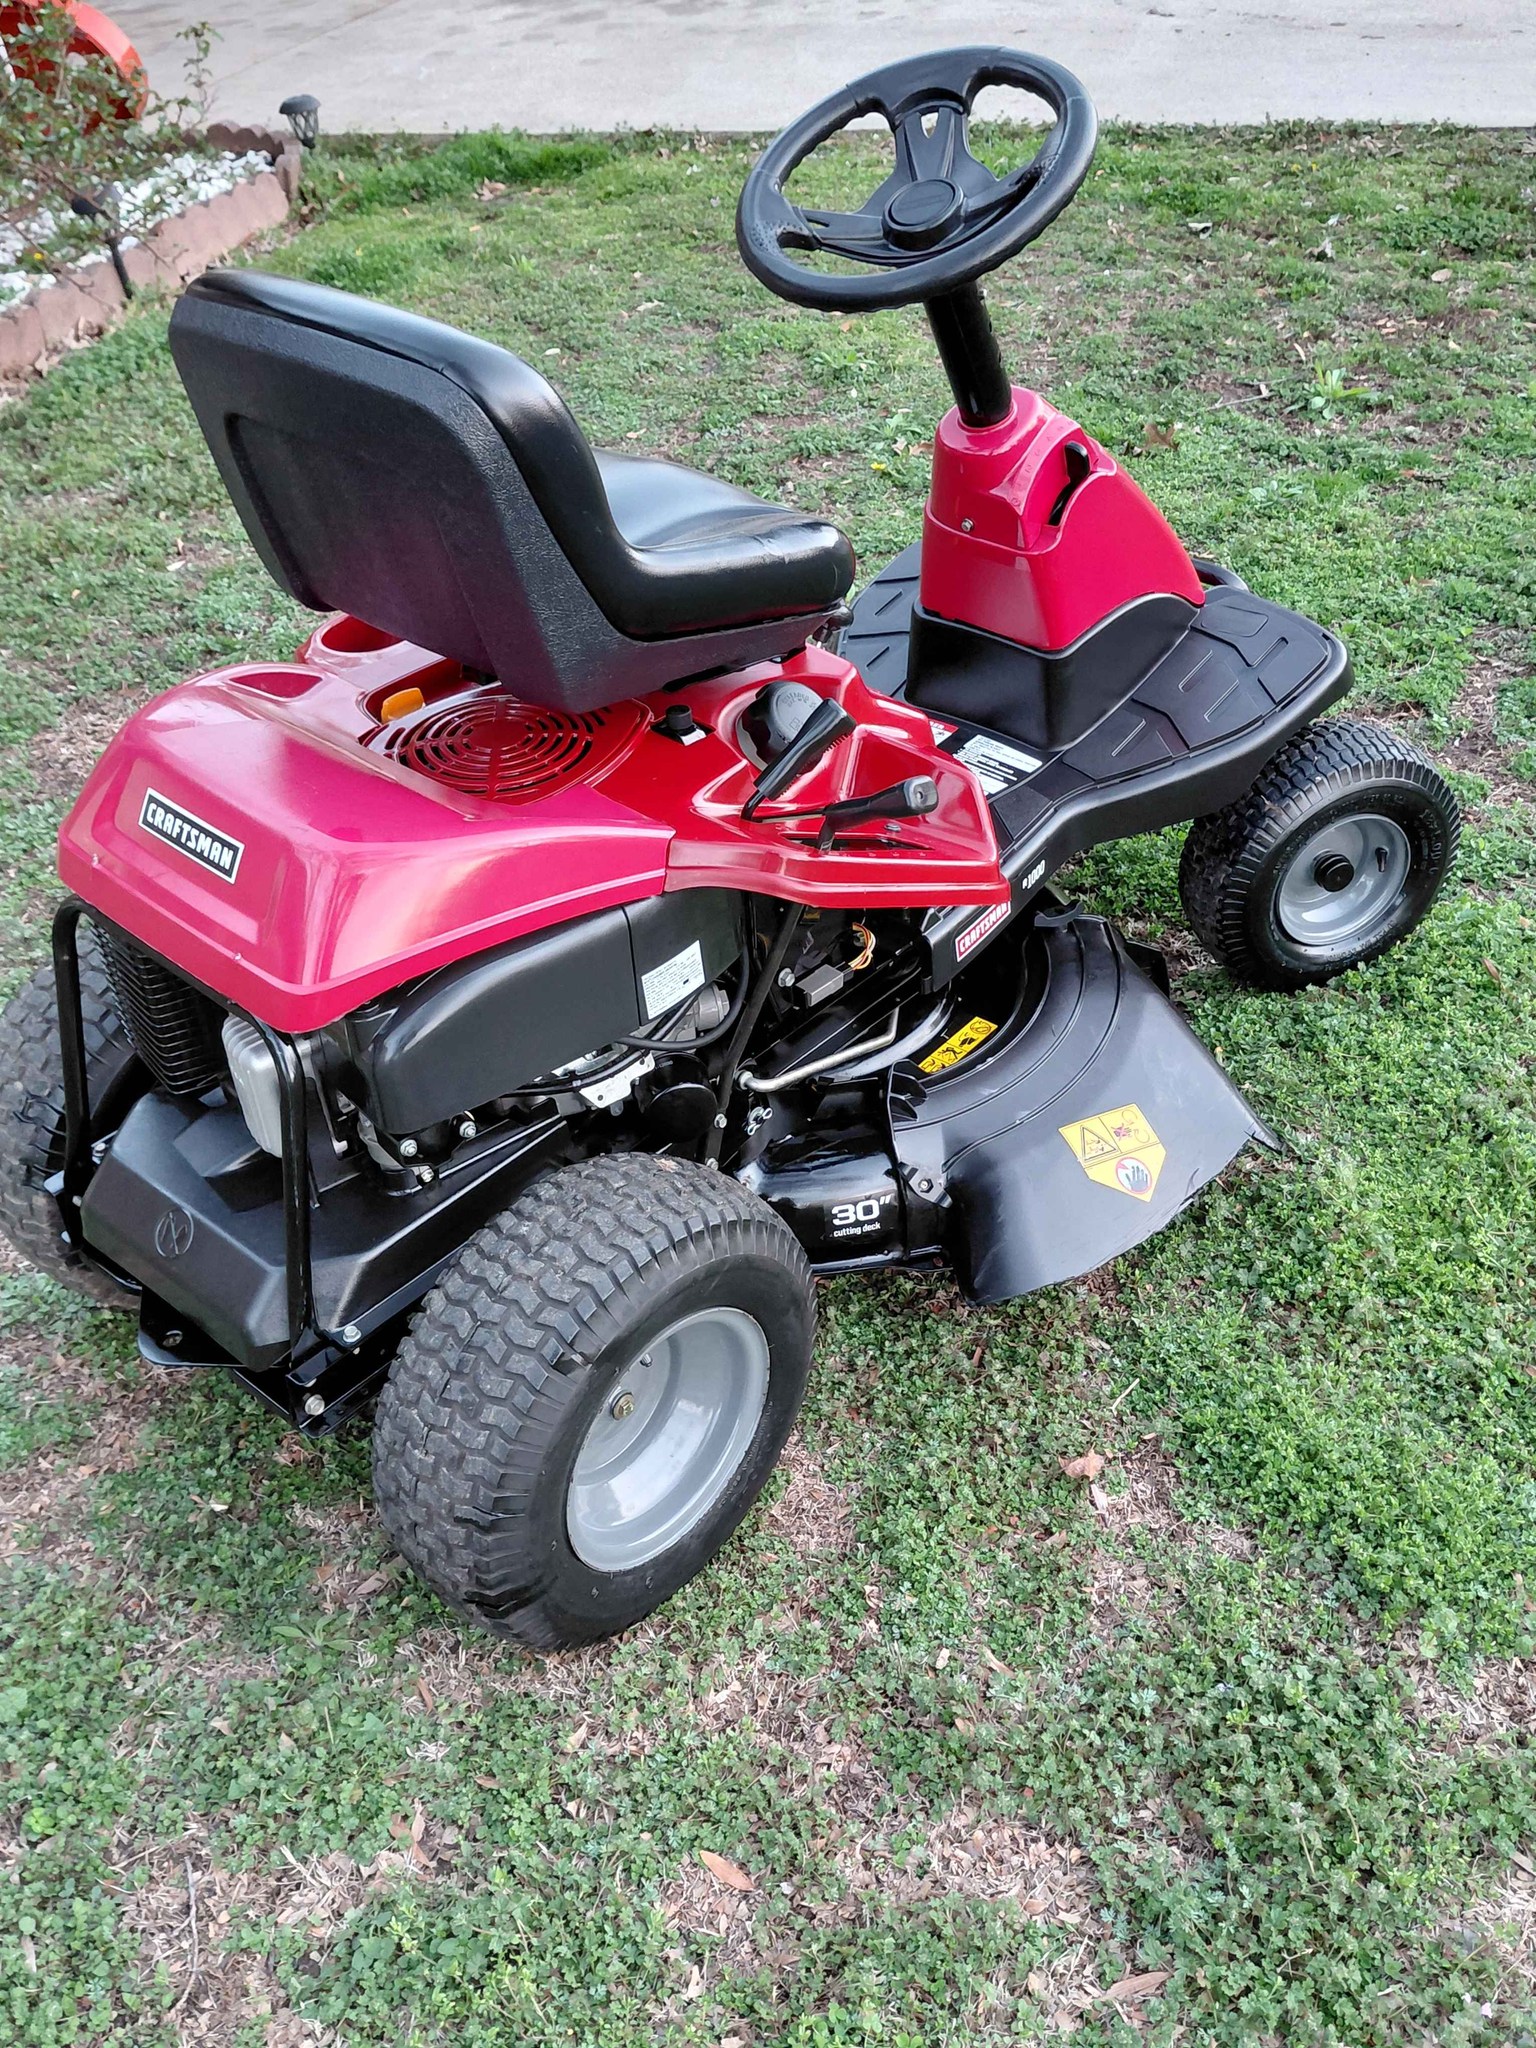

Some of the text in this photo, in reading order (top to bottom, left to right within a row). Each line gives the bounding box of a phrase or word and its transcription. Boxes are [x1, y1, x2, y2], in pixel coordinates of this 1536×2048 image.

[146, 802, 234, 870] CRAFTSMAN
[959, 902, 1008, 953] CRAFTSMAN
[833, 1221, 881, 1237] cutting deck
